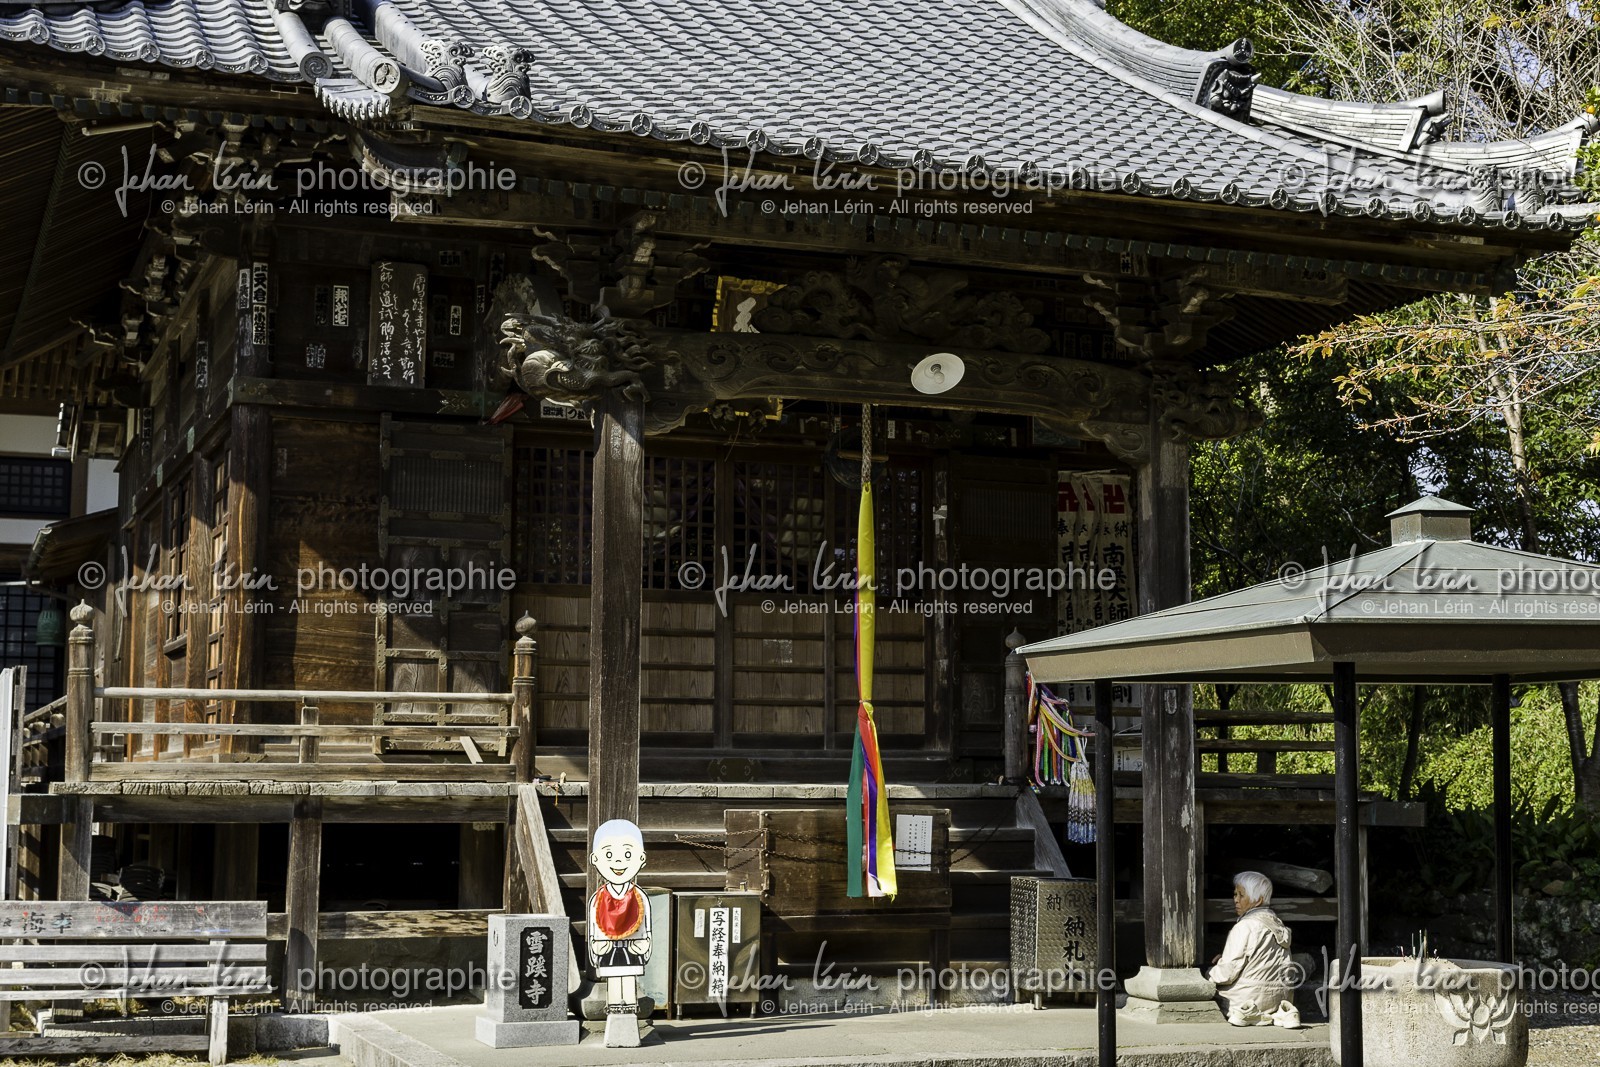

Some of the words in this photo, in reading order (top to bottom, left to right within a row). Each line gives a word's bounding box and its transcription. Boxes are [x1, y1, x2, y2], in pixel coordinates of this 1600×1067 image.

[525, 930, 548, 1005] 雪蹊寺
[711, 910, 727, 994] 写経奉納箱
[1062, 915, 1086, 982] 納札入
